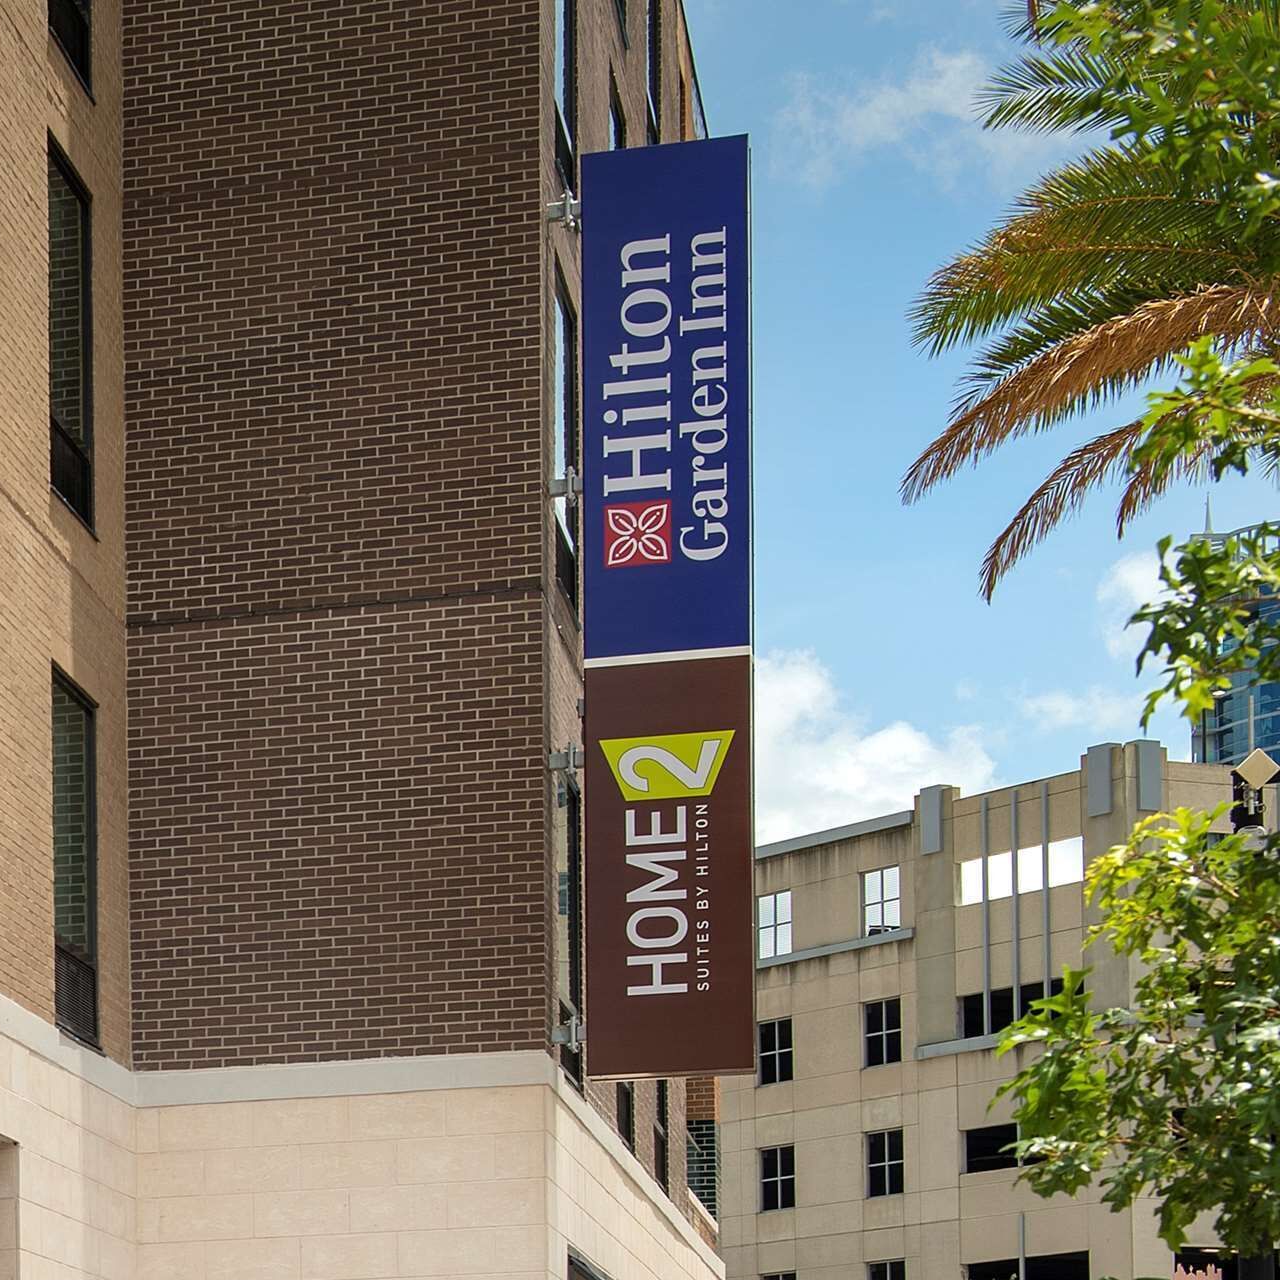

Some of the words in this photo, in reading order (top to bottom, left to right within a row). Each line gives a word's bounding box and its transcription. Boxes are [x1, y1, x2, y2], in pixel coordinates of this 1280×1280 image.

[679, 225, 728, 337] Inn
[603, 232, 673, 498] Hilton
[679, 340, 729, 562] Garden
[695, 803, 709, 876] HILTON
[696, 886, 710, 910] BY
[696, 919, 710, 991] SUITES
